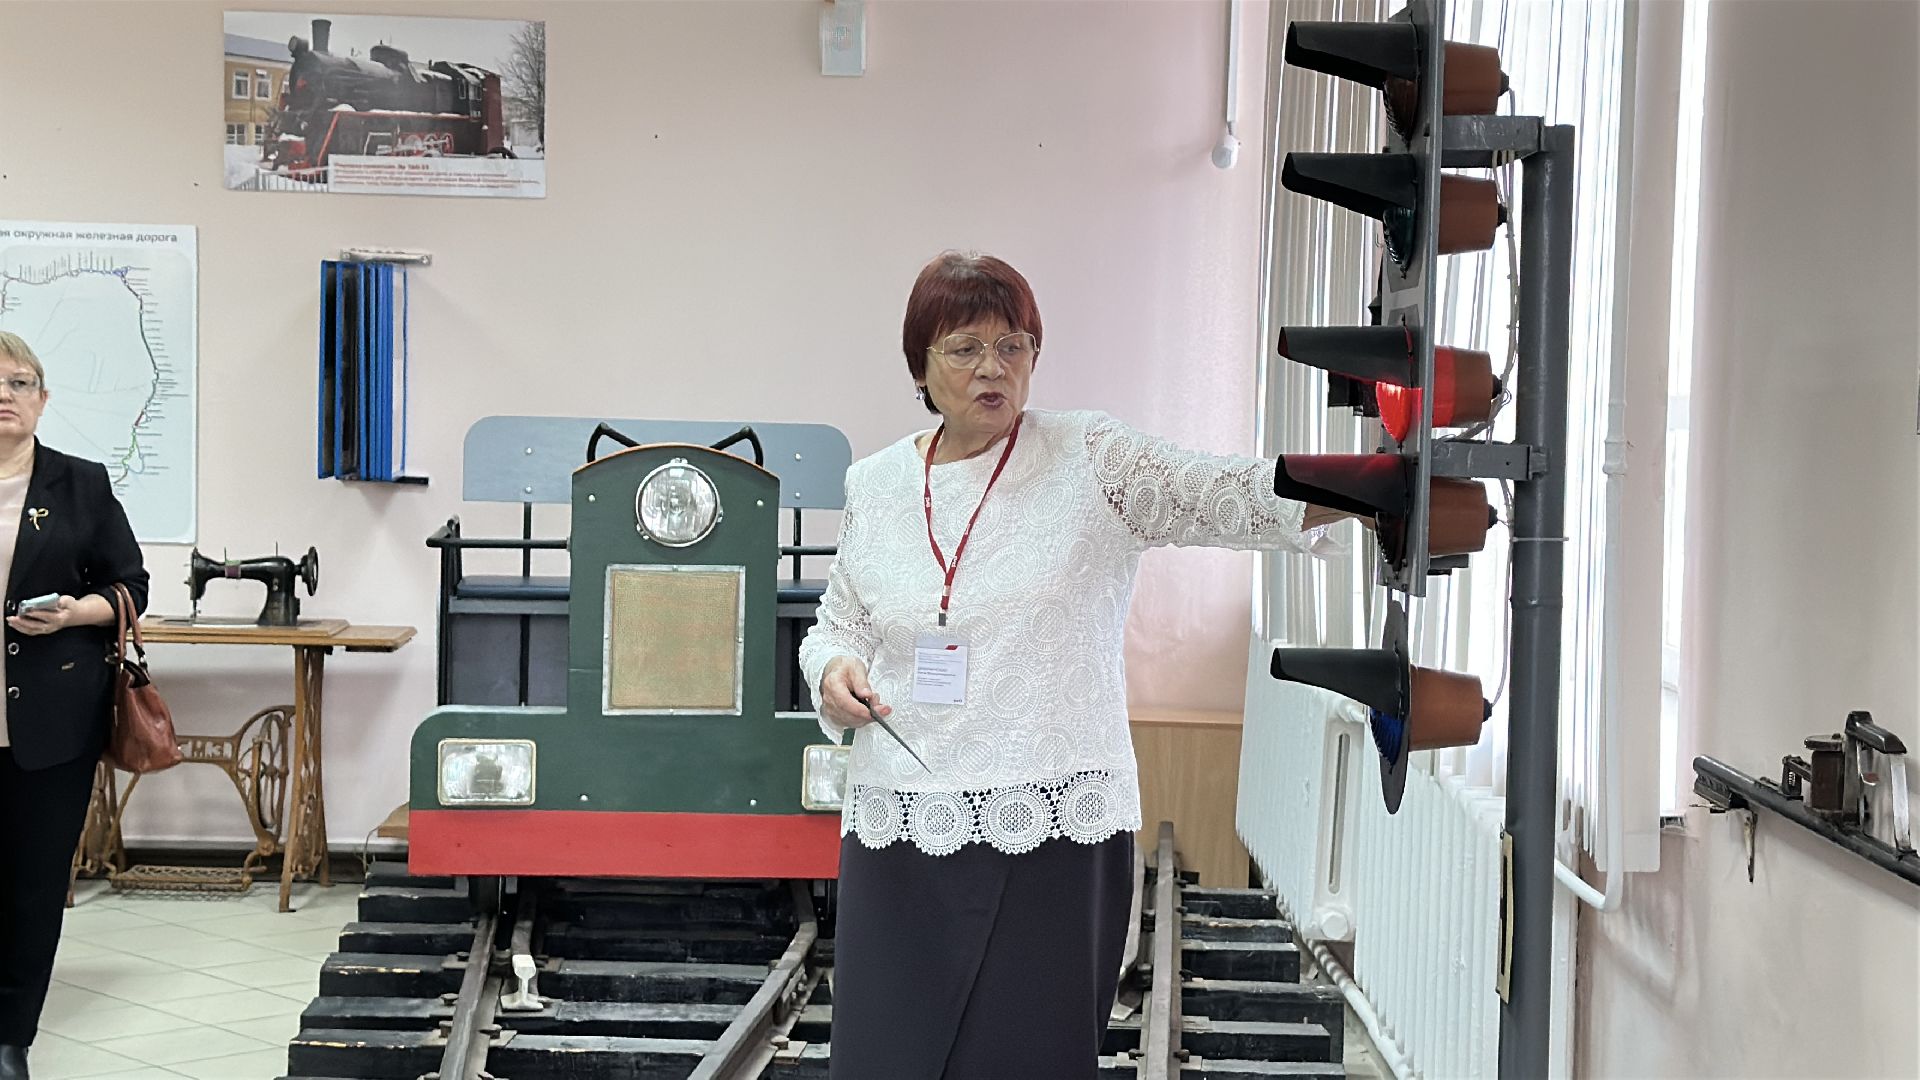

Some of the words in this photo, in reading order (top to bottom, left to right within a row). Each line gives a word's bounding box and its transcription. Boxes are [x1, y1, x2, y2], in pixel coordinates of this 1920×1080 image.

[14, 230, 72, 240] окружная
[75, 232, 133, 241] железная
[136, 233, 177, 243] дорога
